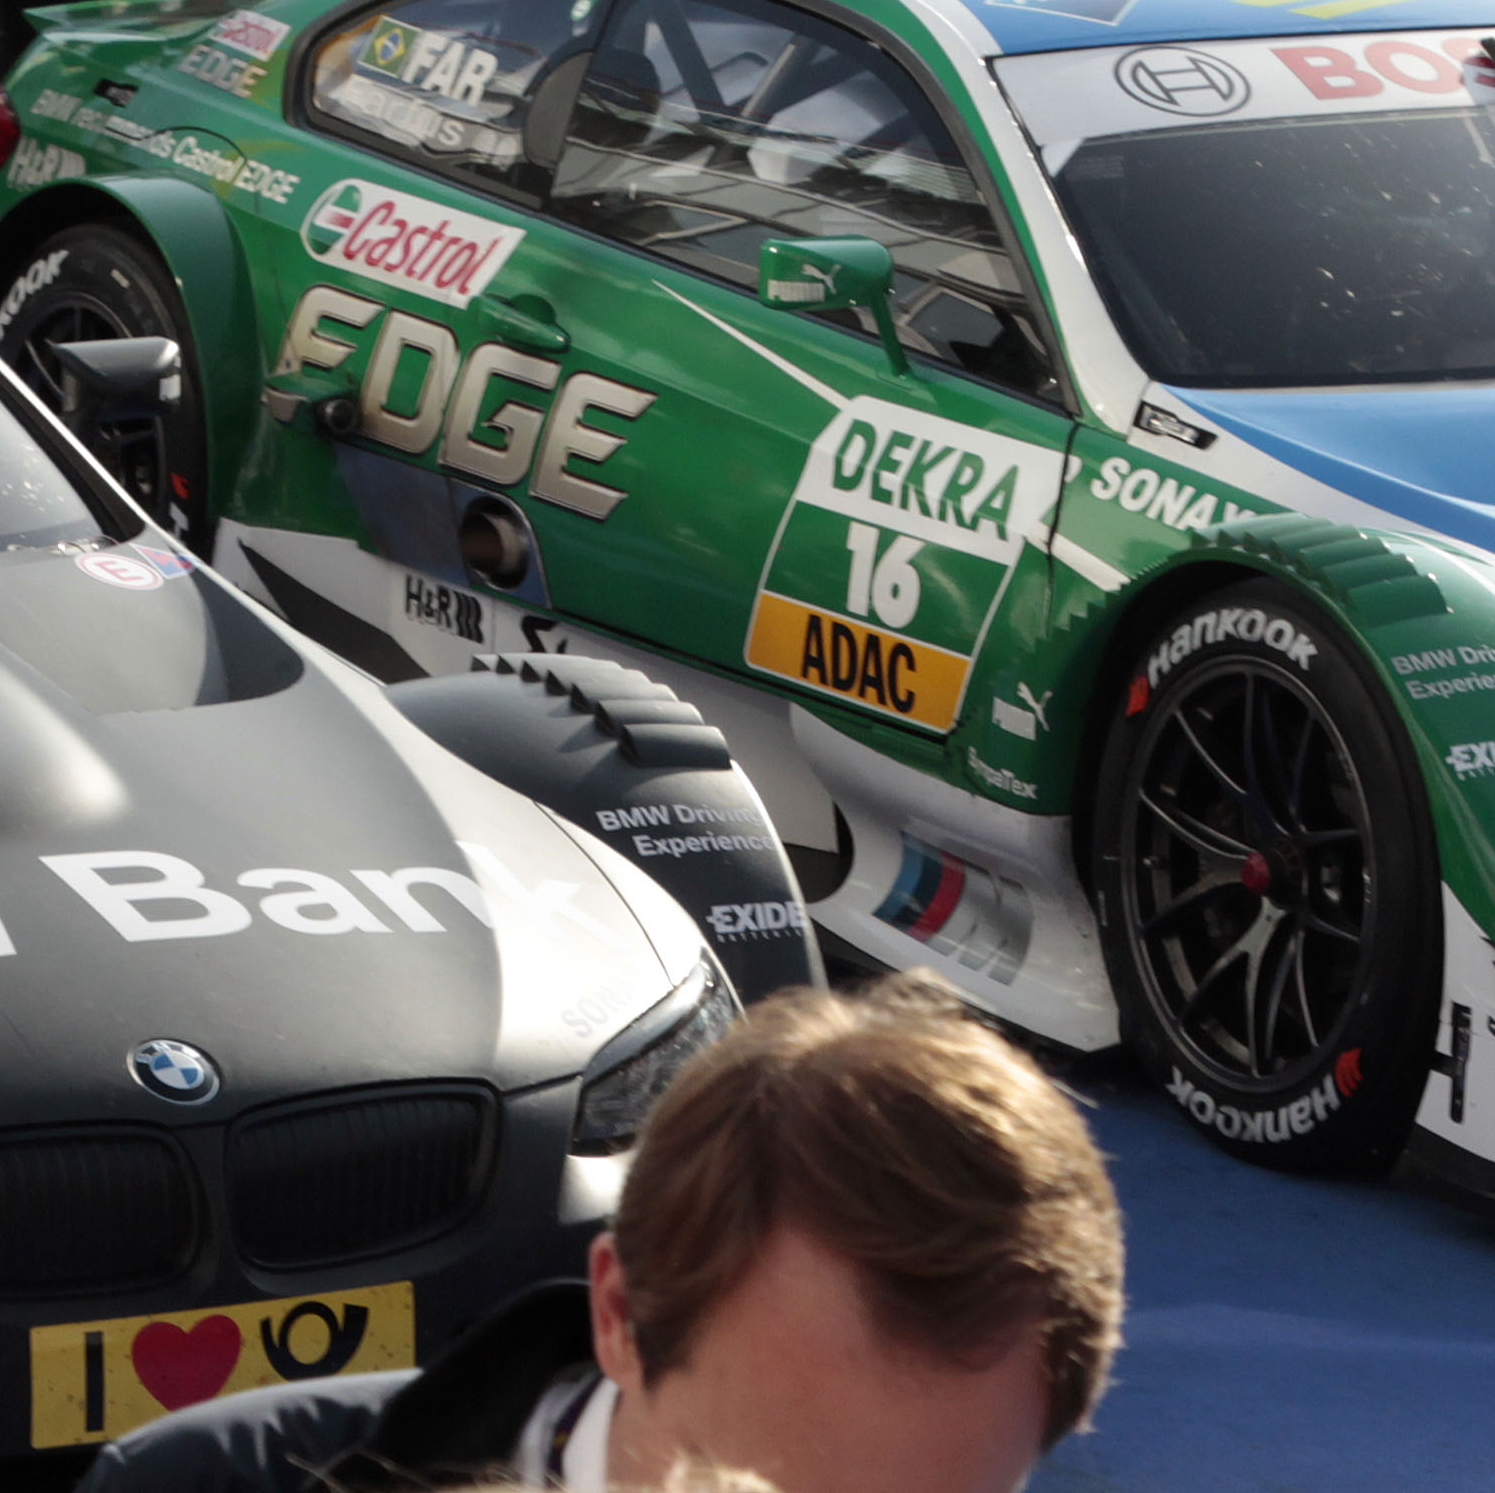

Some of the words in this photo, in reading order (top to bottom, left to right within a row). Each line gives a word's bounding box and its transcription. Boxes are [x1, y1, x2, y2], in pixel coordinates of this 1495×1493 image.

[178, 44, 268, 98] EDGE
[402, 30, 499, 107] FAR
[342, 199, 500, 296] Castrol
[275, 283, 660, 522] EDGE
[831, 419, 1021, 543] DEKRA
[846, 522, 921, 629] 16
[799, 613, 917, 714] ADAC
[1390, 649, 1459, 676] BMW
[596, 805, 672, 832] BMW
[38, 840, 618, 952] Bank
[707, 901, 806, 935] EXIDE
[84, 1331, 104, 1433] I
